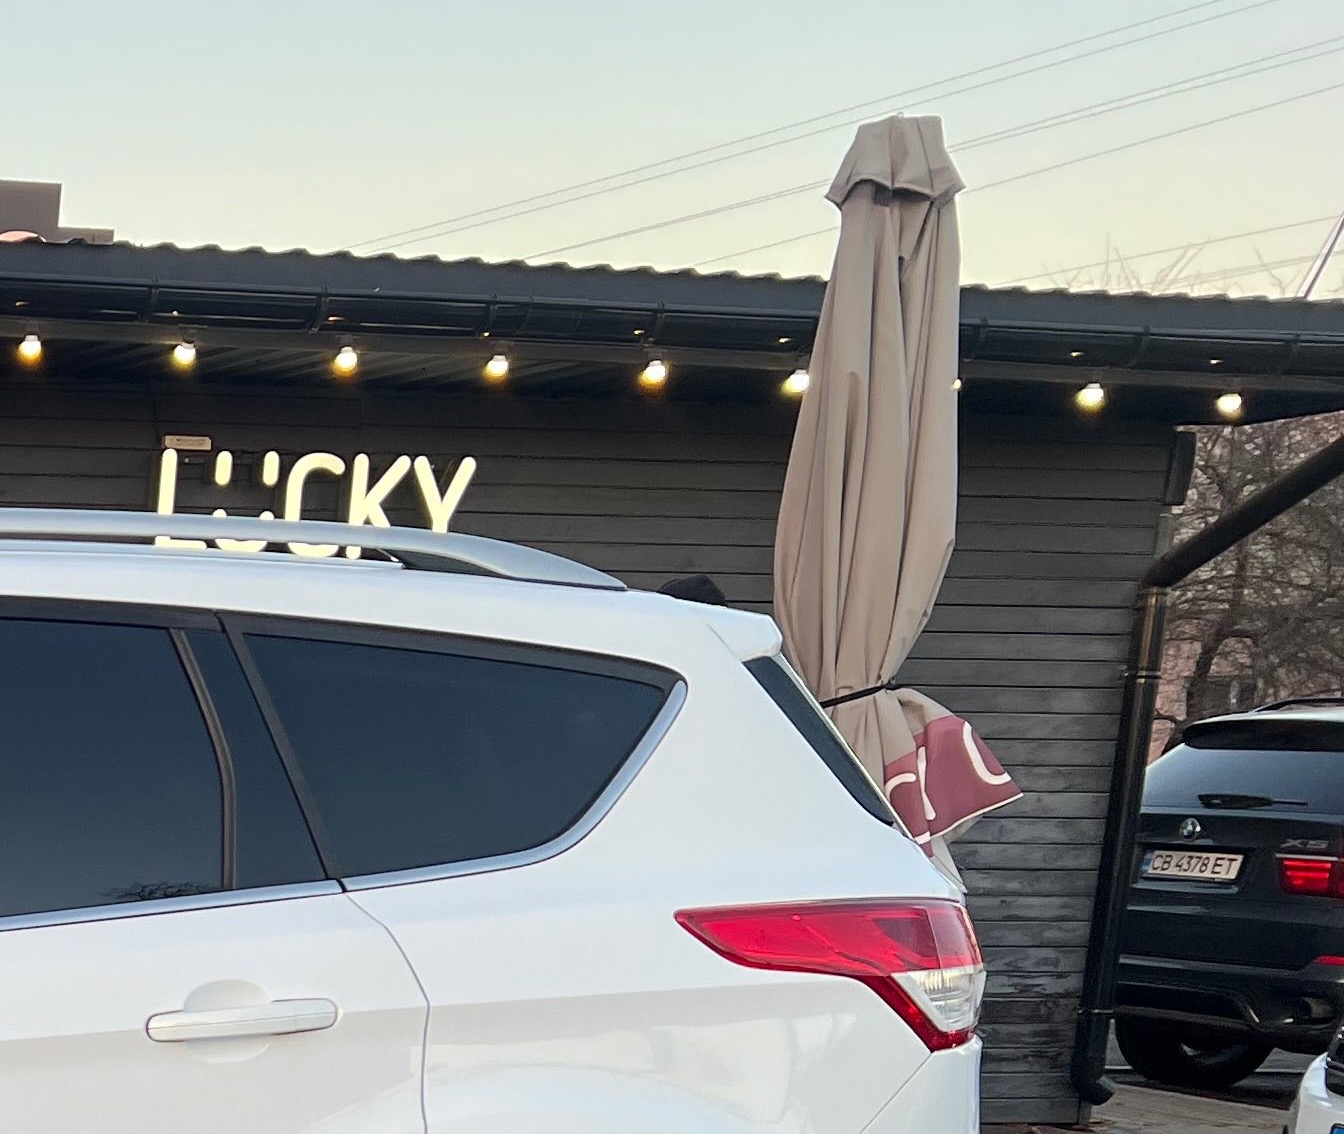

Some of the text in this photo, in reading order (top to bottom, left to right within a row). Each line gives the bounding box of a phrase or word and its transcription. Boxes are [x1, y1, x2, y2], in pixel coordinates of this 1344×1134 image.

[154, 448, 477, 560] LUCKY
[1151, 854, 1238, 875] CB 4378 ET
